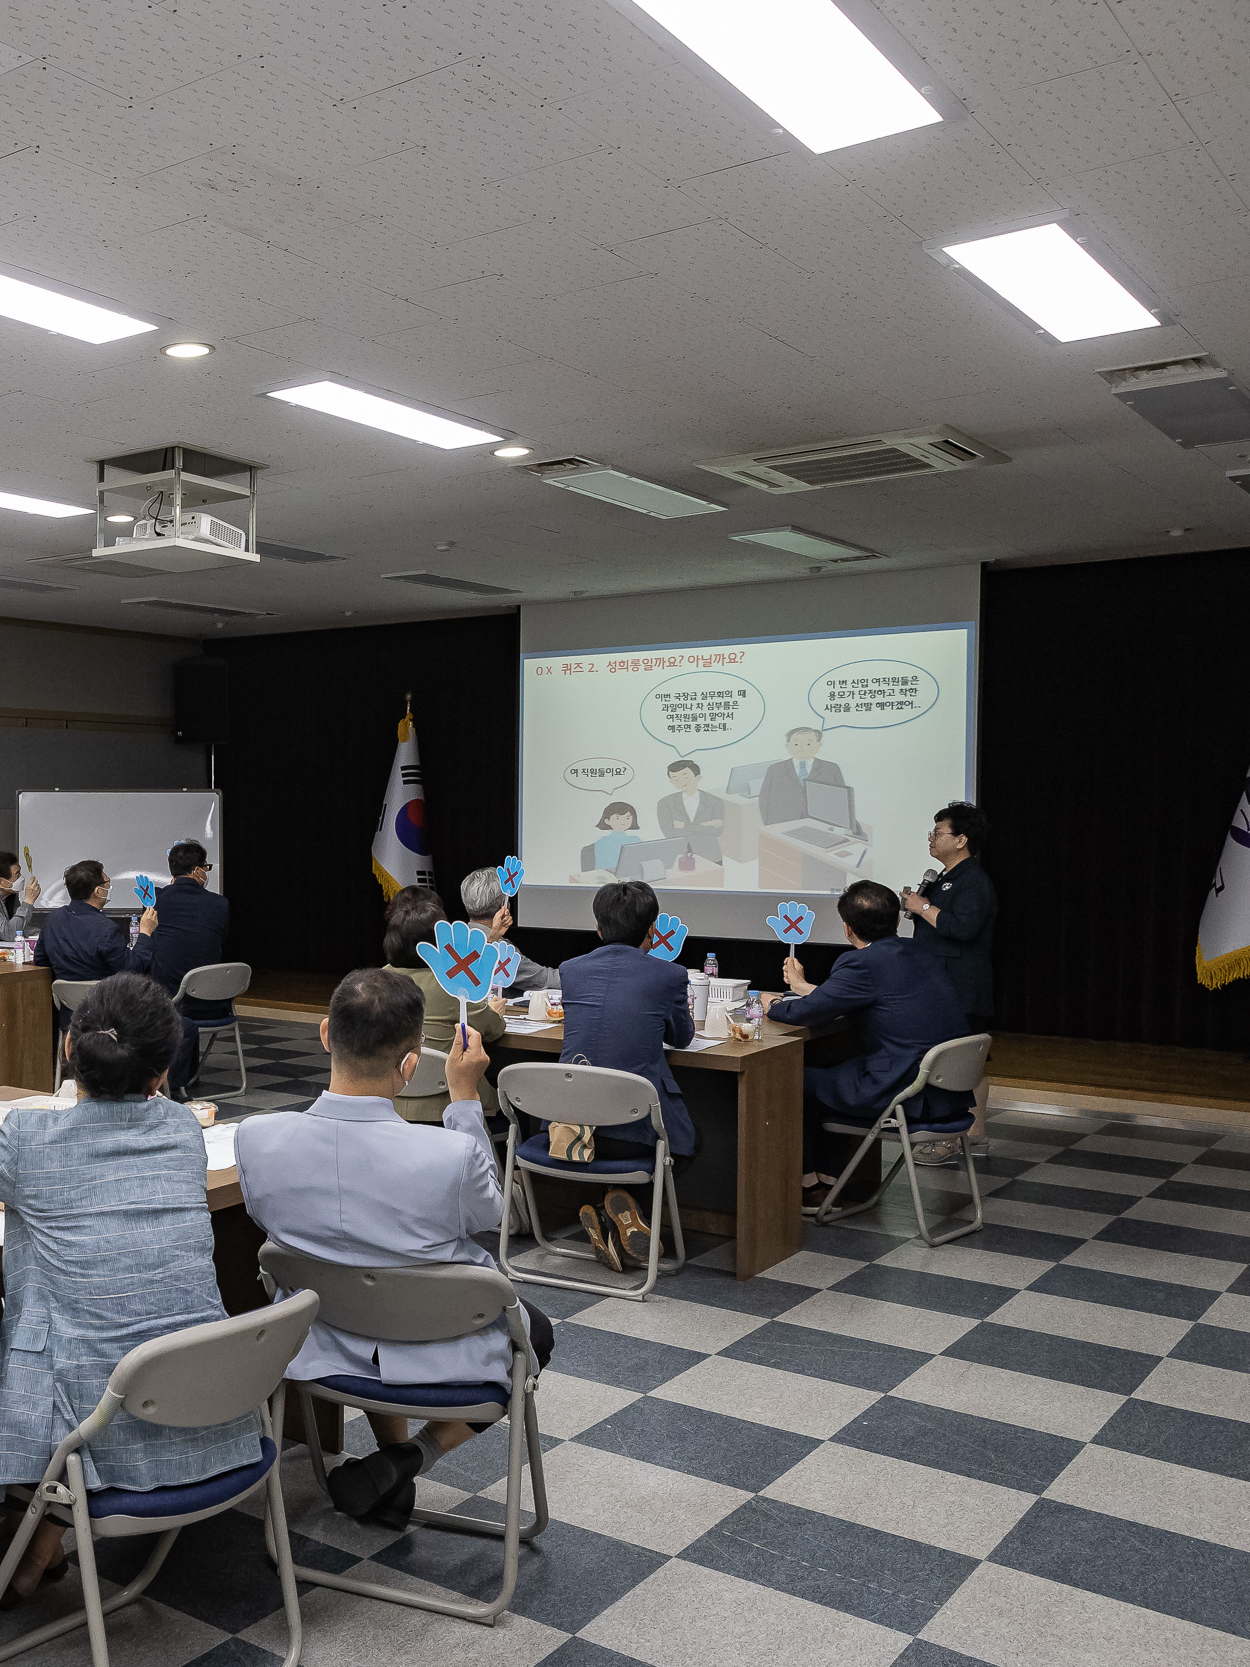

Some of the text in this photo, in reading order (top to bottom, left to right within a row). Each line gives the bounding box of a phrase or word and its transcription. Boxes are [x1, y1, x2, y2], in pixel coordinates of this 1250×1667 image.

[561, 663, 584, 676] 퀴즈
[587, 662, 598, 673] 2.
[606, 655, 684, 674] 성희롱일까요?
[687, 651, 746, 668] 아닐까요?
[826, 676, 920, 689] 이 번 신입 여직원들은
[655, 693, 671, 702] 이번
[674, 692, 698, 701] 국장급
[700, 690, 733, 700] 실무회의
[828, 688, 918, 701] 용모가 단정하고 착한
[661, 702, 693, 712] 과일이나
[706, 700, 740, 710] 심부름은
[824, 702, 851, 713] 사람을
[854, 702, 872, 712] 선발
[666, 712, 706, 722] 여직원들이
[667, 724, 692, 734] 해주면
[570, 767, 627, 778] 여 직원들이요?
